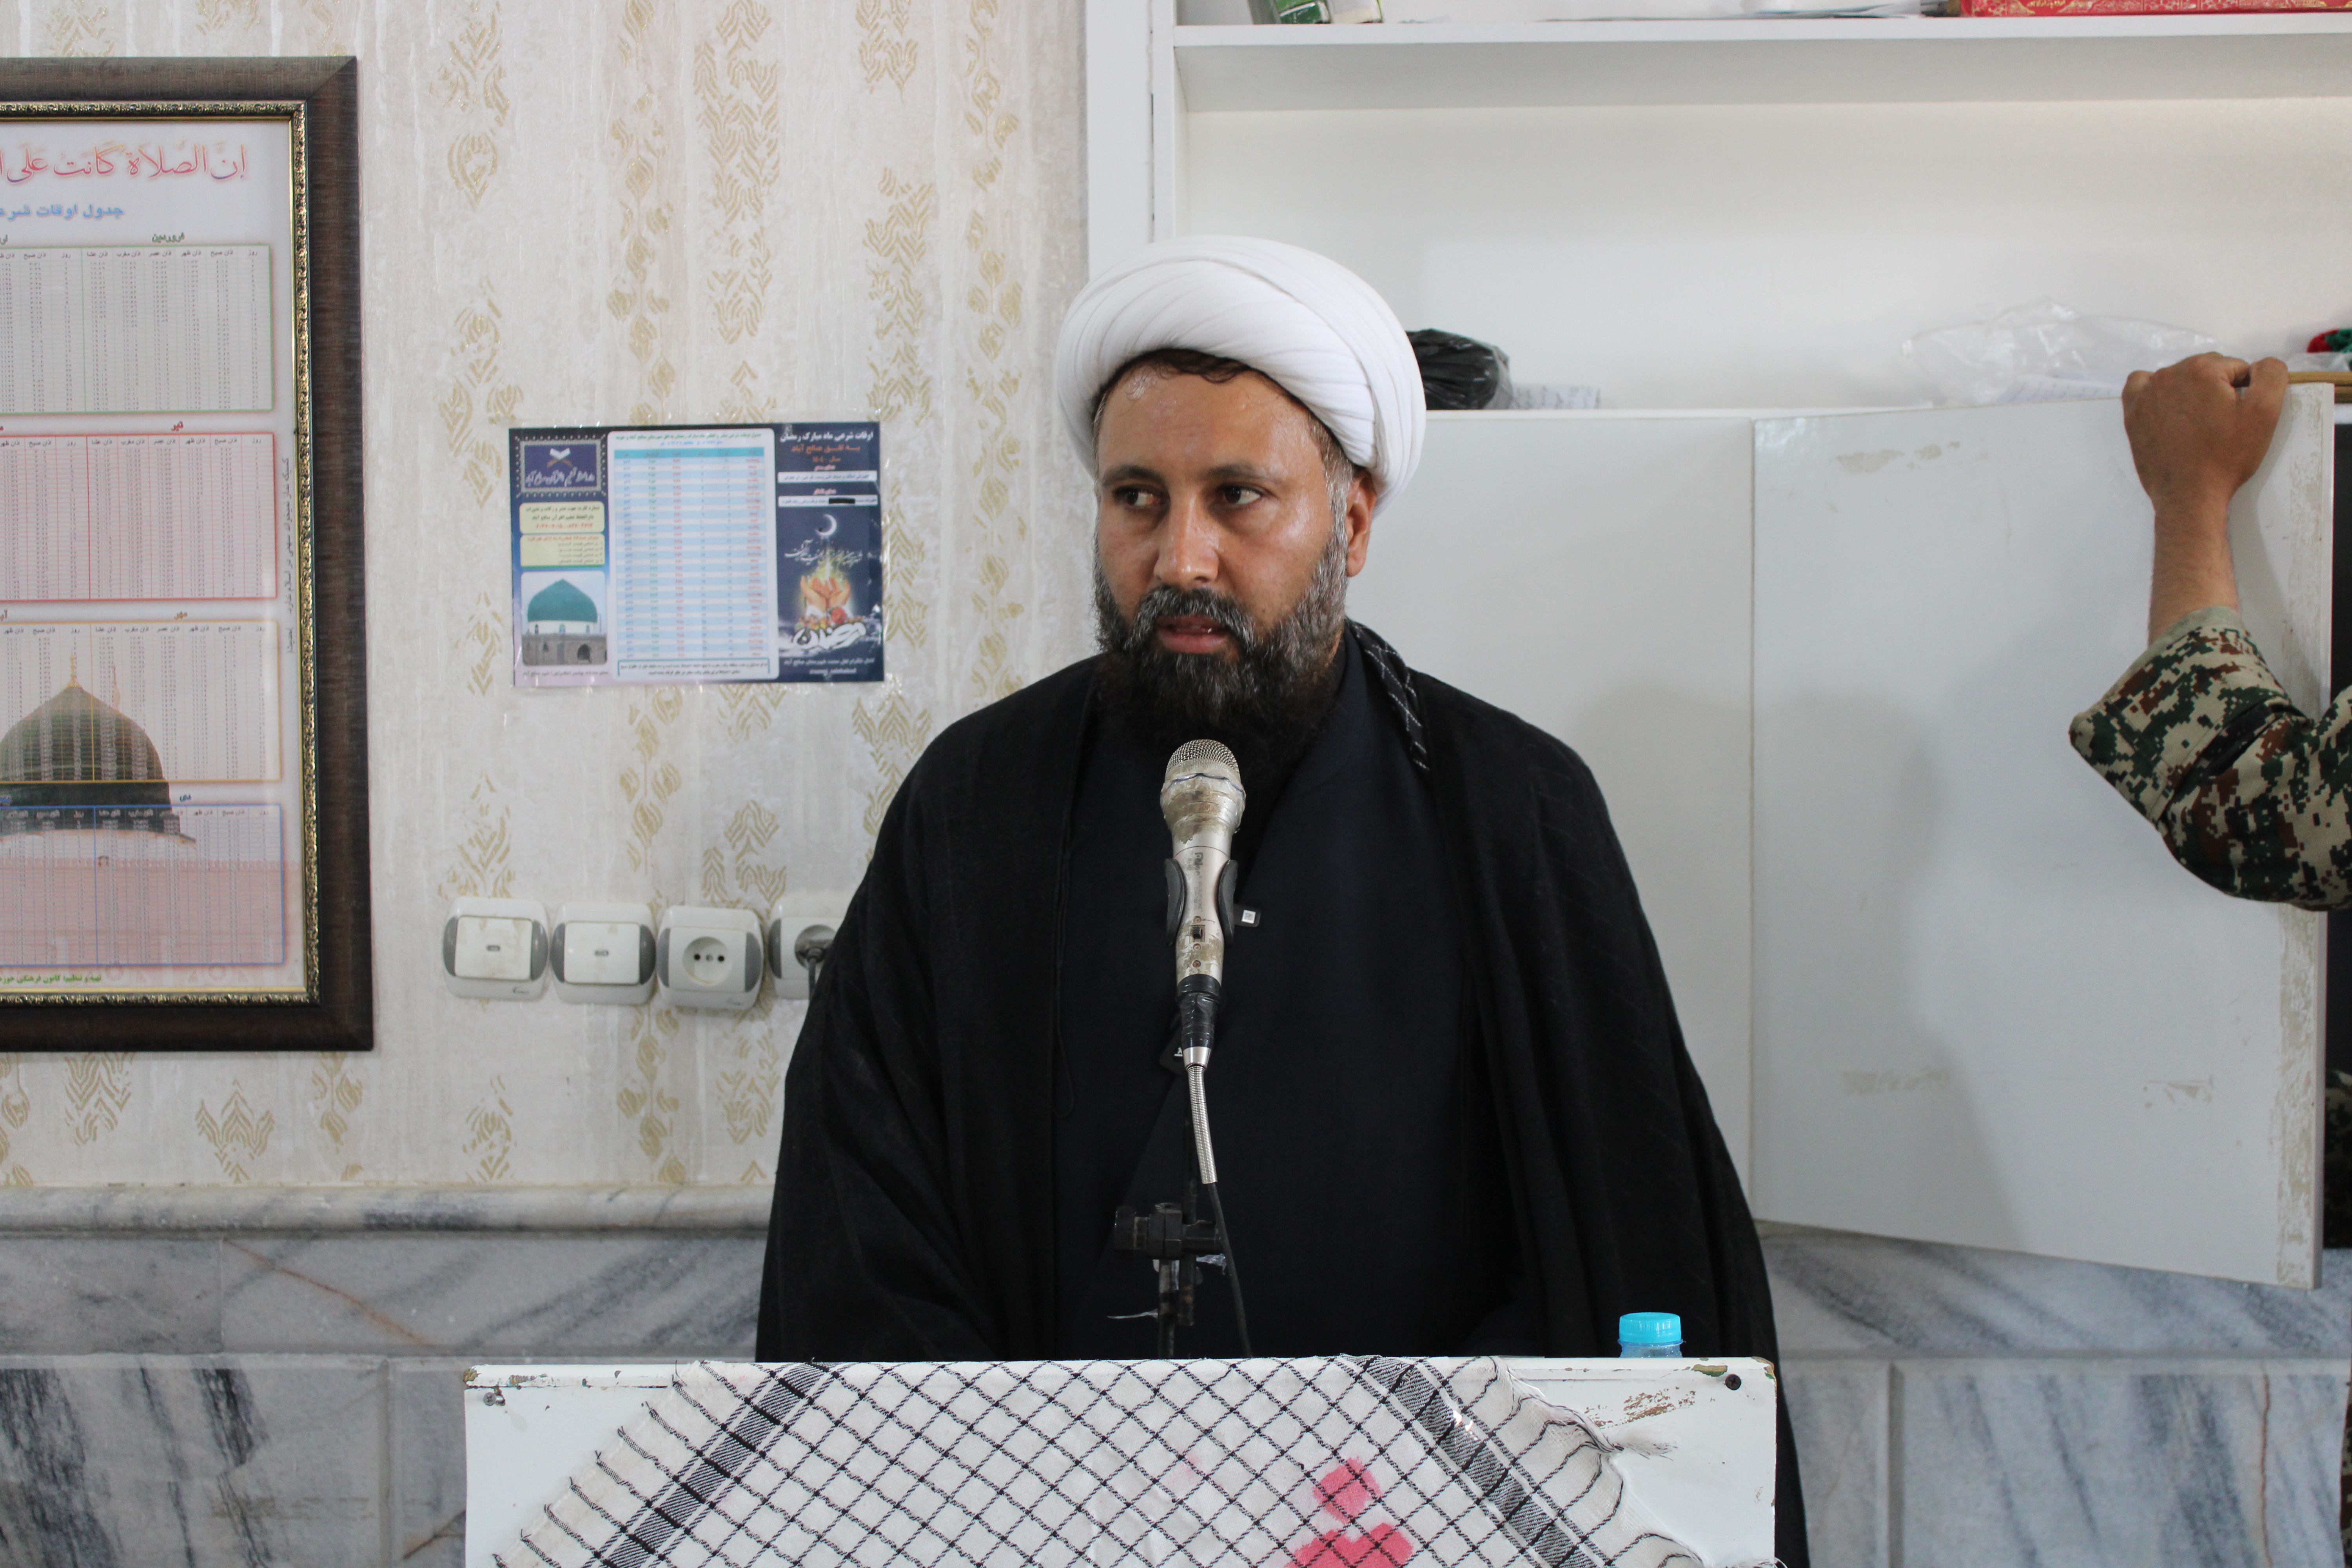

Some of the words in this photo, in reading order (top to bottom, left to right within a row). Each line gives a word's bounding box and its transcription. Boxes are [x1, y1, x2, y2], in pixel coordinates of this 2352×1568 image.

[0, 204, 31, 220] شرع
[36, 204, 76, 219] اوقات
[83, 204, 123, 218] جدول
[780, 432, 802, 443] رمضان
[802, 431, 822, 442] مبارک
[823, 431, 833, 440] ماه
[834, 431, 853, 442] شرعی
[855, 430, 873, 442] اوقات
[791, 443, 805, 452] آباد
[806, 444, 823, 454] صالح
[793, 622, 866, 650] رمضان
